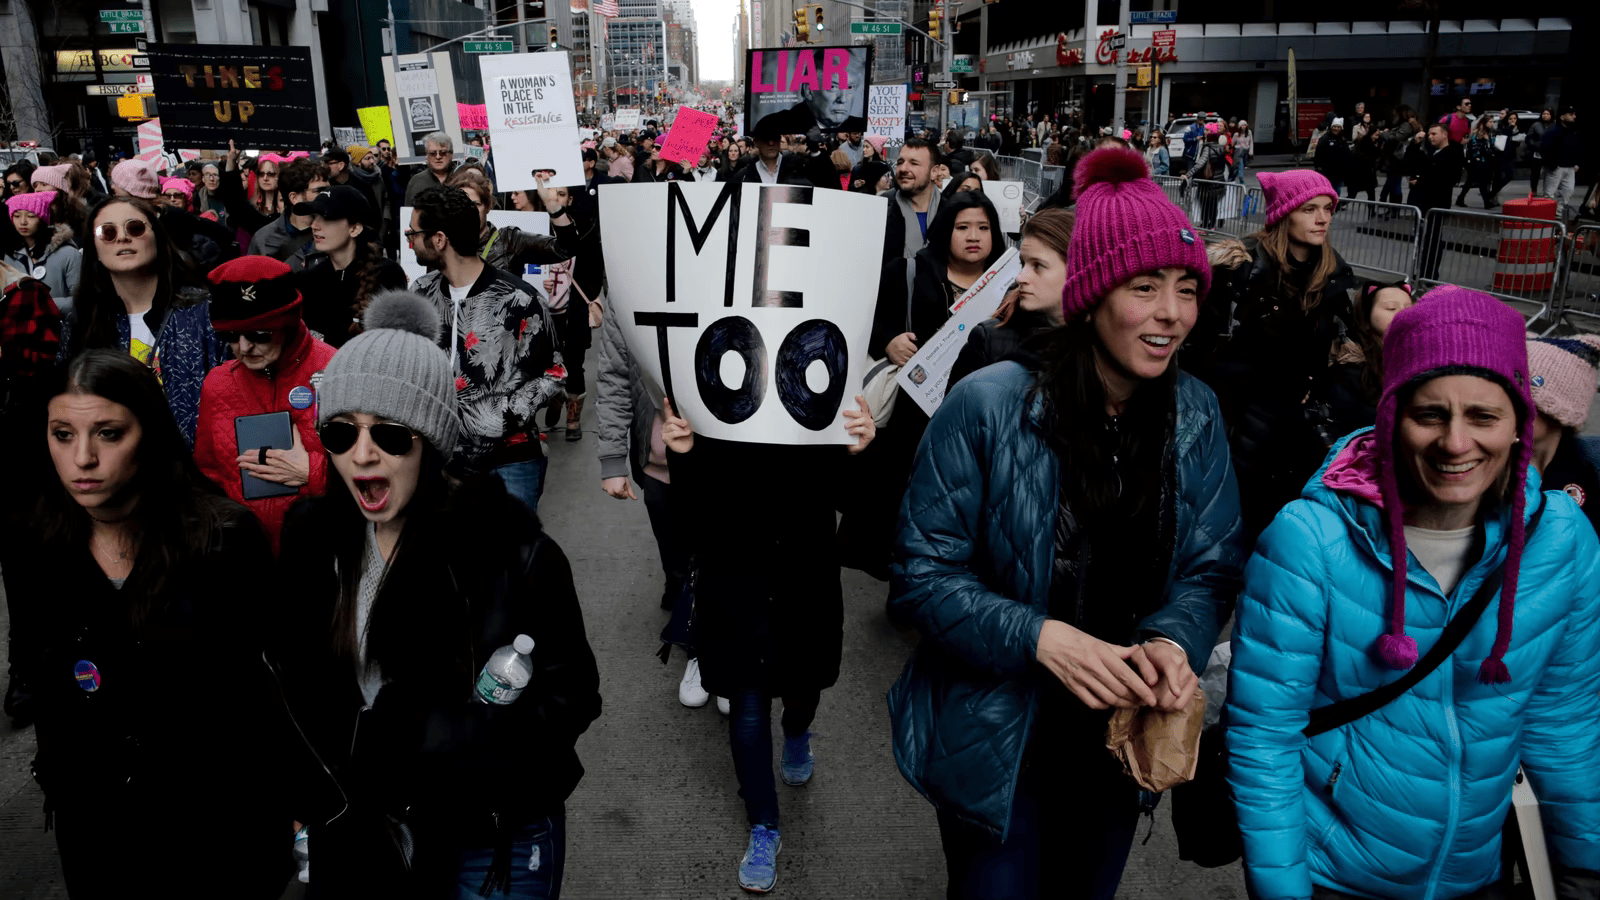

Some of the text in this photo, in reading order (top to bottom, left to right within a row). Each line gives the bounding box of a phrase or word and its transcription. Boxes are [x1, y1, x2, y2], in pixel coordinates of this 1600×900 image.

[110, 23, 116, 32] W
[120, 24, 132, 32] 46
[872, 24, 880, 32] 46
[750, 48, 850, 93] LIAR
[500, 74, 556, 90] A WOMAN'S
[100, 85, 124, 94] HSBC
[502, 88, 544, 102] PLACE IS
[876, 86, 898, 96] YOU
[870, 96, 900, 105] AINT
[213, 100, 254, 123] UP
[503, 102, 535, 115] IN THE
[870, 106, 898, 114] SEEN
[872, 126, 894, 136] YET
[666, 181, 814, 308] ME
[926, 346, 940, 360] Donald
[942, 330, 956, 342] Trump
[634, 312, 848, 432] TOO
[924, 388, 934, 398] Are
[934, 378, 943, 390] you
[930, 396, 938, 404] for
